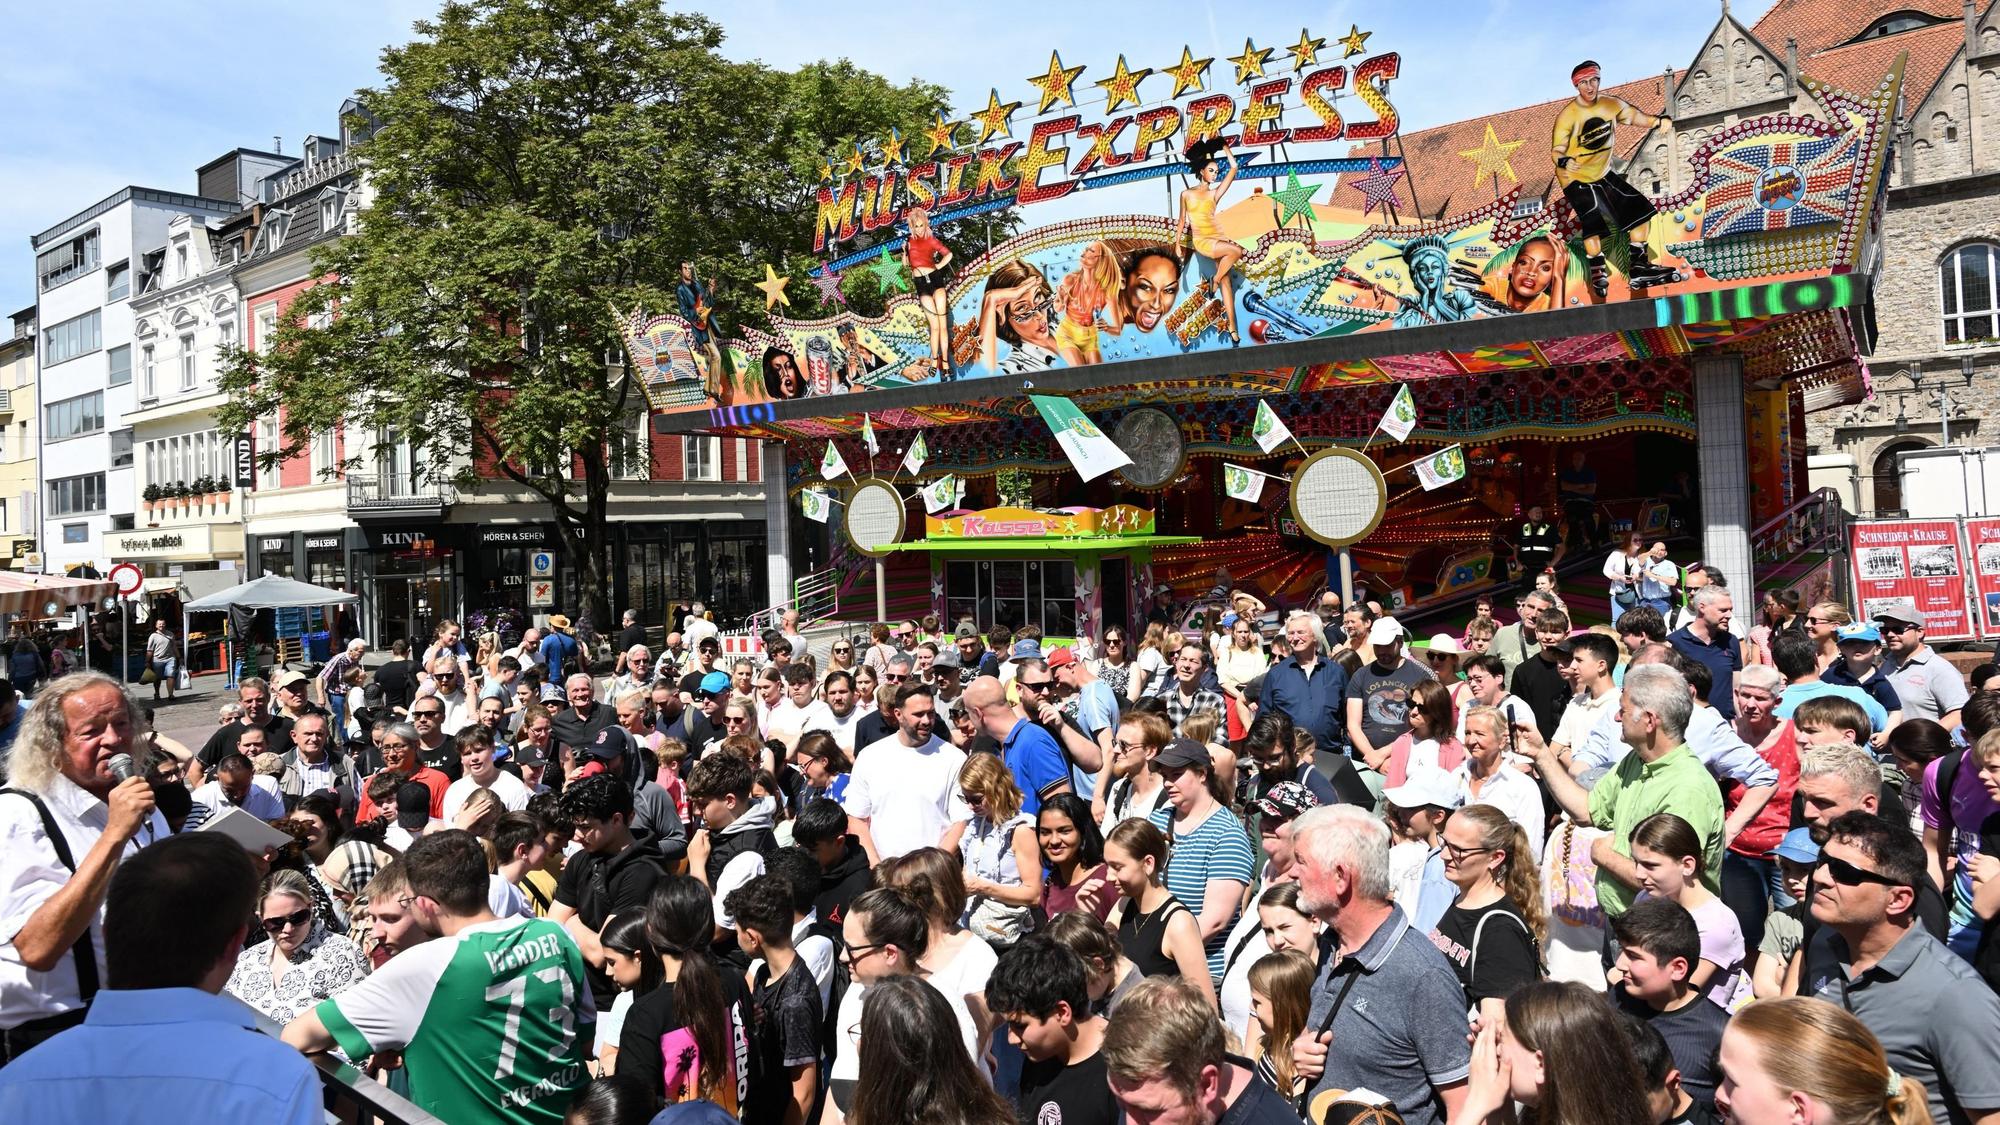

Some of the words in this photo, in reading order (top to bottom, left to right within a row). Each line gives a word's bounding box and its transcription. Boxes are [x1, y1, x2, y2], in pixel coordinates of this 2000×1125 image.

[813, 141, 1024, 254] MUSIK
[1015, 52, 1401, 206] EXPRESS
[238, 440, 251, 480] KIND
[483, 530, 510, 541] HÖREN
[519, 532, 545, 540] SEHEN
[963, 516, 1047, 537] Kasse
[263, 539, 281, 550] KIND
[1365, 683, 1381, 694] LOS
[1382, 680, 1410, 692] ANGEL
[484, 932, 561, 976] WERDER
